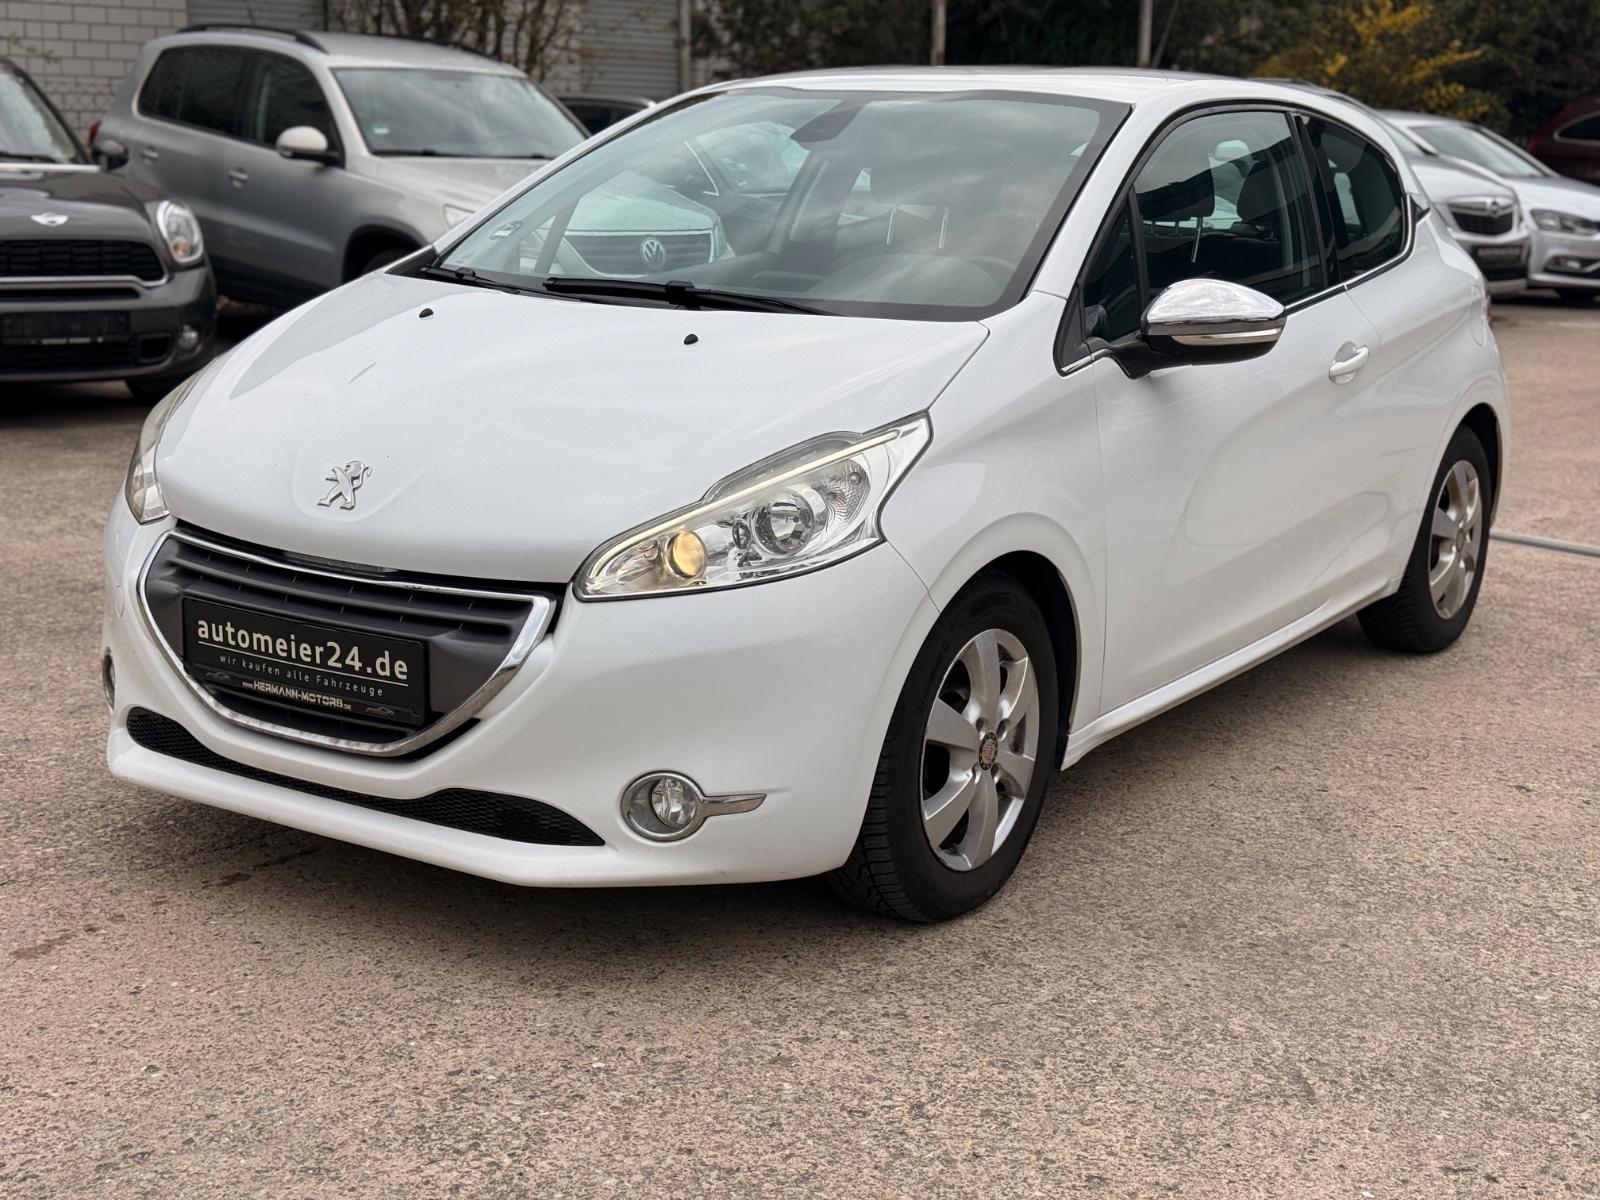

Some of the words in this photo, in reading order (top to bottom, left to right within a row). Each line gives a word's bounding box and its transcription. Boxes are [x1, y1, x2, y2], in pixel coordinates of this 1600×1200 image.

[198, 619, 409, 680] automeier24.de
[220, 655, 236, 665] wir
[242, 659, 280, 676] kaufen
[286, 670, 310, 682] alle
[316, 675, 383, 697] Fahrzeuge
